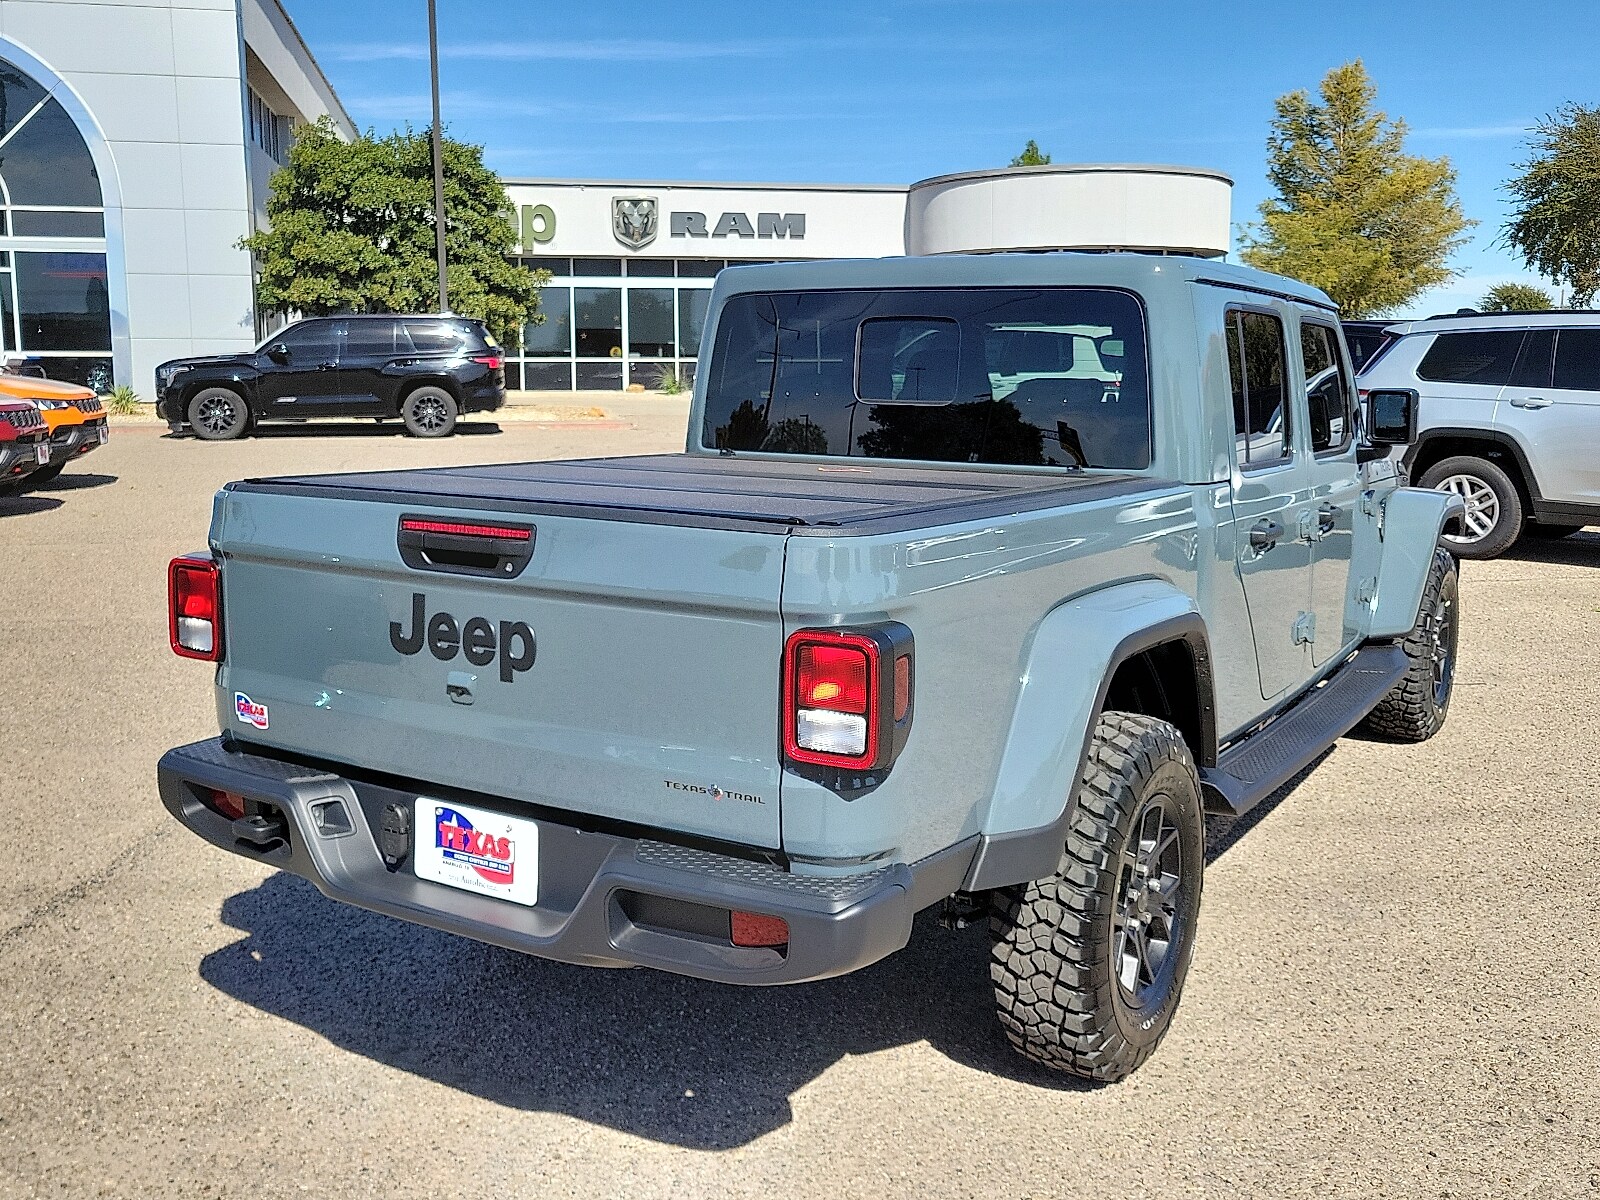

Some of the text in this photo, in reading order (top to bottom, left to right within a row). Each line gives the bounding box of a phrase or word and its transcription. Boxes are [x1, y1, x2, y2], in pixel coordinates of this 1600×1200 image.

[670, 211, 806, 238] RAM
[389, 593, 537, 683] Jeep
[664, 780, 766, 805] TEXAS TRAIL
[439, 824, 511, 861] TEXAS
